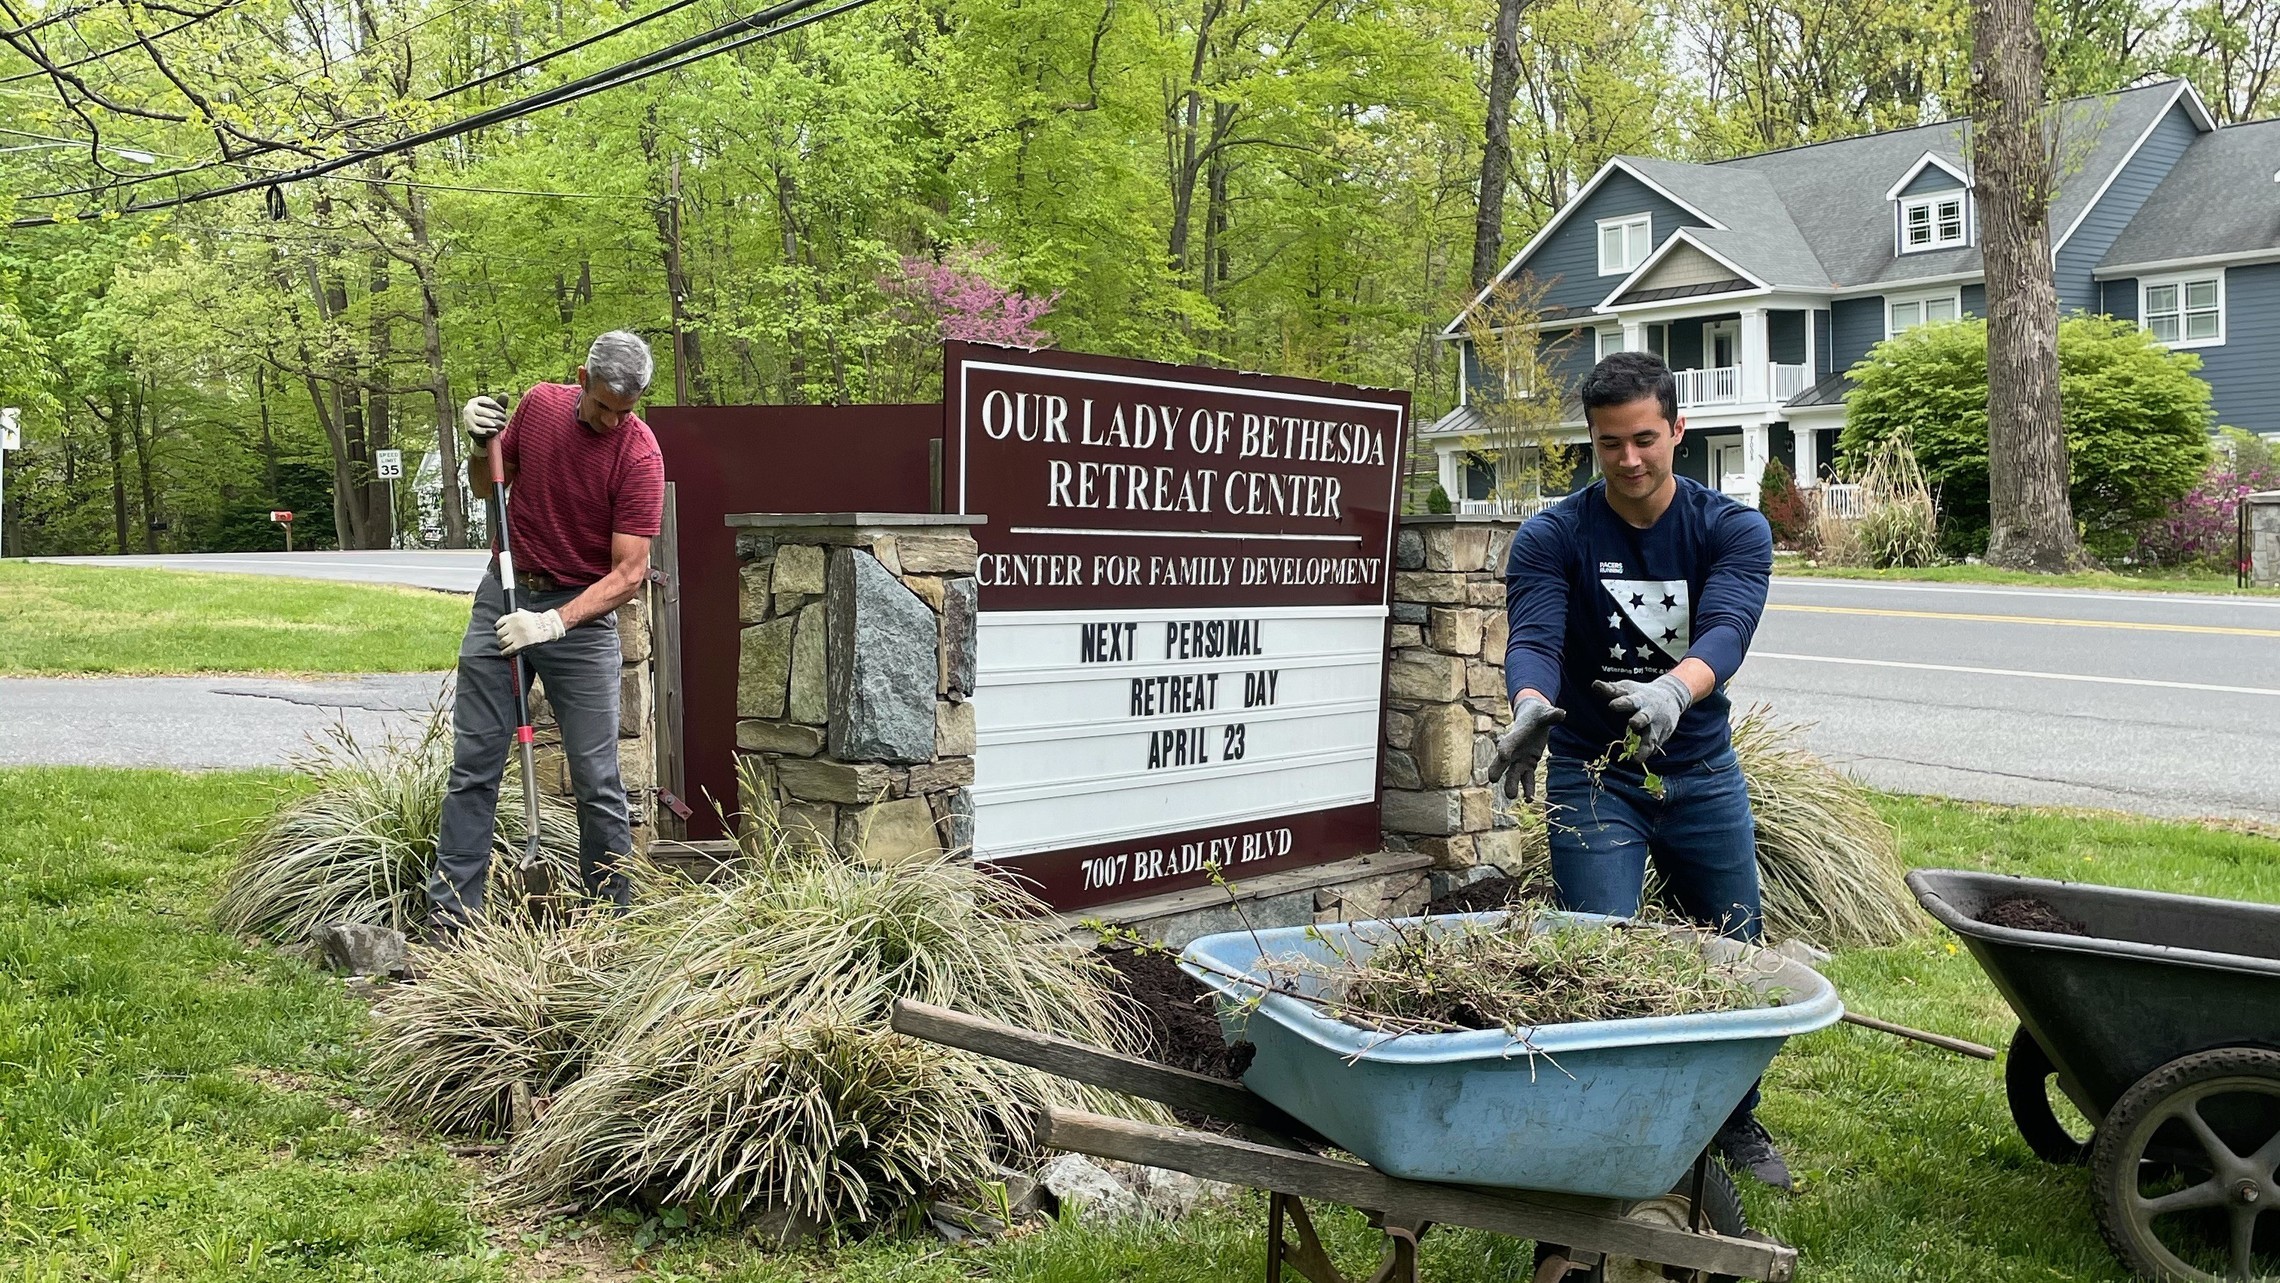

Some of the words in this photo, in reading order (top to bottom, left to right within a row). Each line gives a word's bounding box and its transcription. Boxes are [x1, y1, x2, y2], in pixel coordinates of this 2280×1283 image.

[981, 389, 1070, 444] OUR
[1081, 398, 1184, 451] LADY
[1189, 408, 1235, 455] OF
[1240, 413, 1387, 466] BETHESDA
[381, 464, 400, 476] 35
[1047, 459, 1219, 514] RETREAT
[1224, 469, 1343, 520] CENTER
[976, 552, 1083, 587] CENTER
[1092, 555, 1143, 587] FOR
[1148, 556, 1236, 587] FAMILY
[1241, 557, 1382, 586] DEVELOPMENT
[1081, 623, 1138, 664] NEXT
[1166, 619, 1263, 660] PERSONAL
[1131, 673, 1219, 716] RETREAT
[1244, 669, 1279, 708] DAY
[1147, 727, 1209, 770] APRIL
[1223, 724, 1246, 761] 23
[1081, 854, 1129, 891] 7007
[1134, 836, 1238, 882] BRADLEY
[1240, 828, 1294, 864] BLVD
